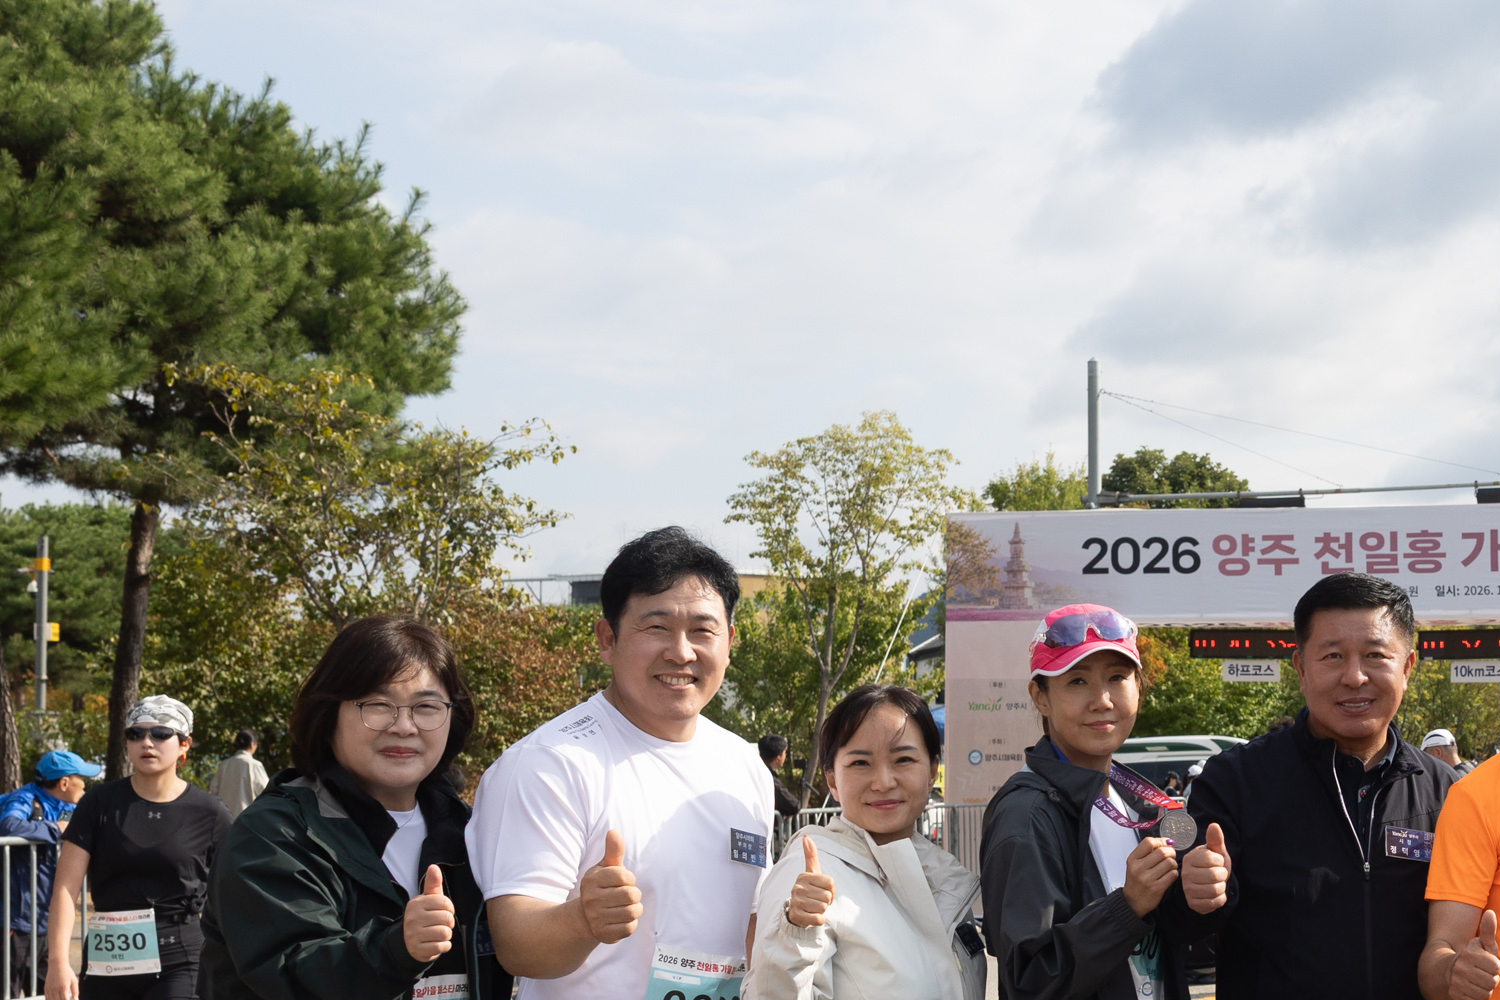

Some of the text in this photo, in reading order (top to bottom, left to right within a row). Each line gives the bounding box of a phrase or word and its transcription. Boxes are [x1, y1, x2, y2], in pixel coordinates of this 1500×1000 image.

[1082, 536, 1201, 575] 2026
[1212, 533, 1300, 576] 양주
[1313, 530, 1447, 575] 천일홍
[1434, 585, 1460, 597] 일시:
[1464, 585, 1494, 596] 2026.
[1228, 664, 1274, 677] 하프코스
[94, 932, 146, 952] 2530
[658, 953, 679, 965] 2026
[680, 958, 696, 969] 양주
[696, 961, 719, 973] 천일홍
